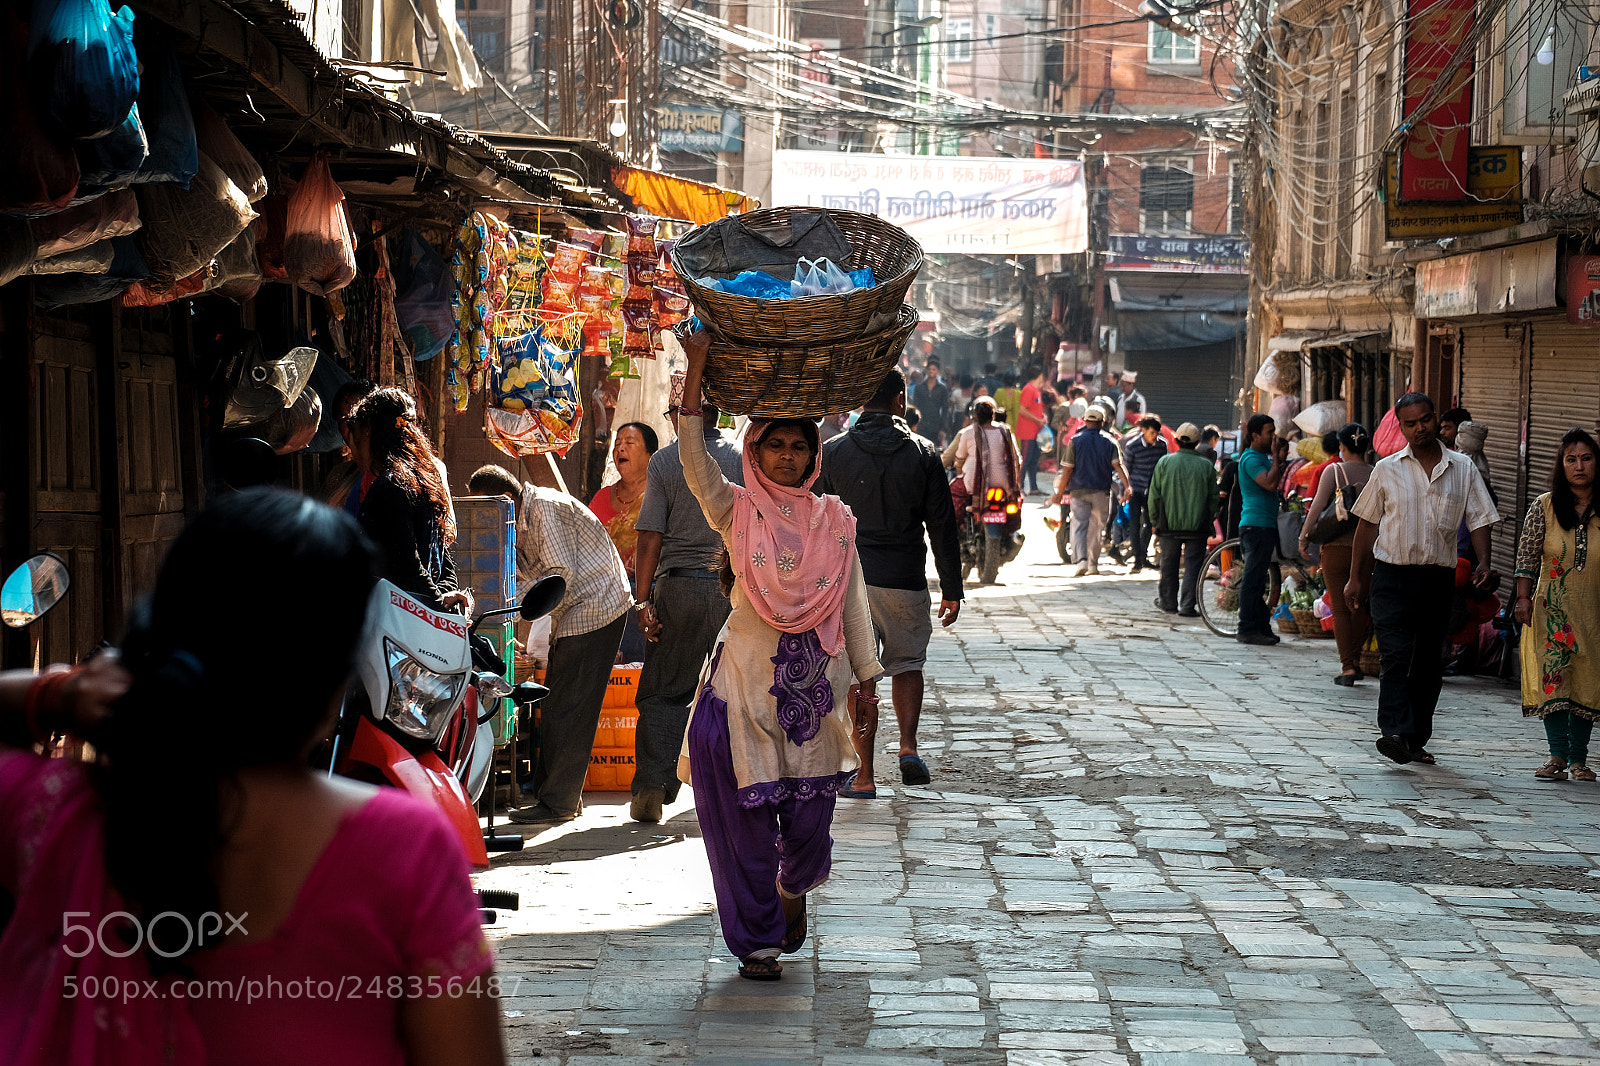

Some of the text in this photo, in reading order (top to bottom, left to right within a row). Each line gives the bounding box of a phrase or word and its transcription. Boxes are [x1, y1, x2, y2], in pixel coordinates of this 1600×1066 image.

[418, 648, 449, 664] HONDA
[607, 676, 632, 686] MILK
[598, 716, 637, 729] VA MIL
[609, 755, 635, 764] MILK
